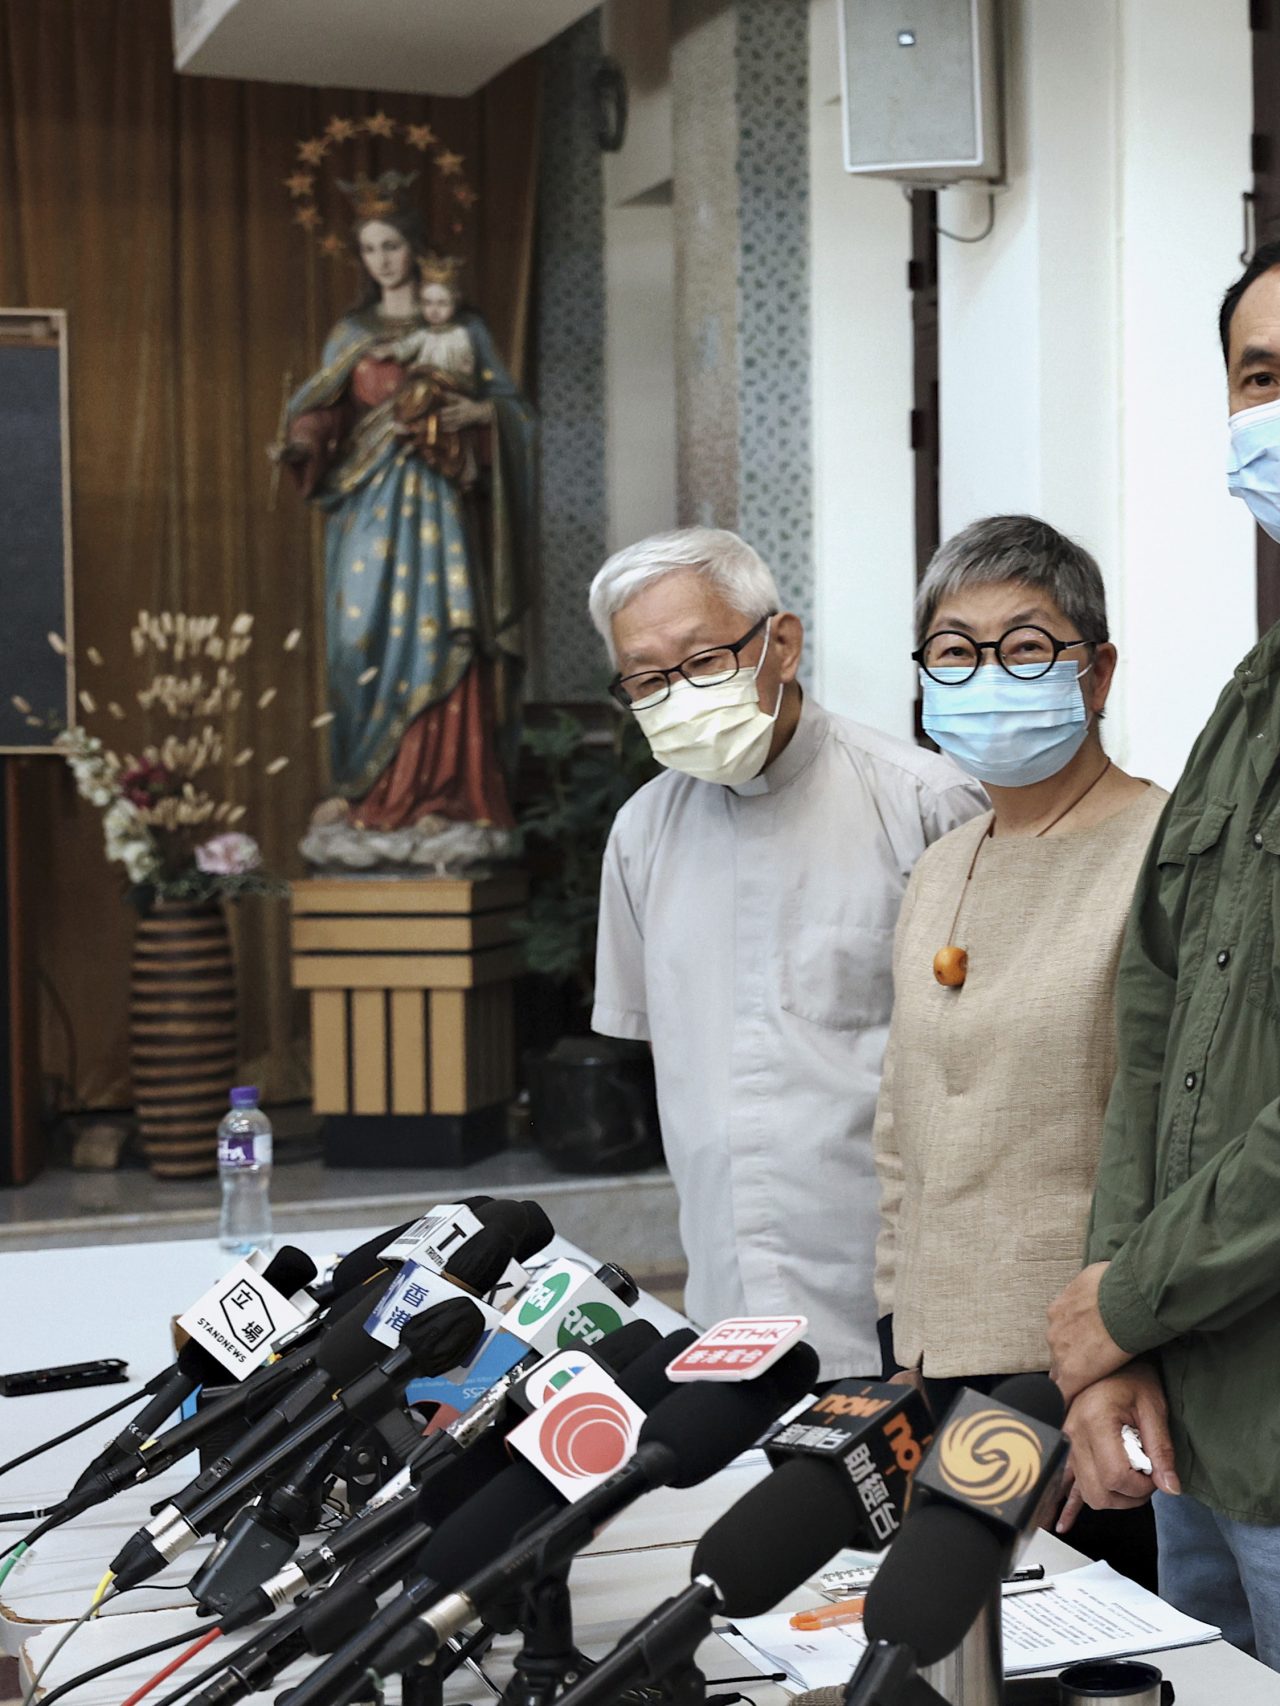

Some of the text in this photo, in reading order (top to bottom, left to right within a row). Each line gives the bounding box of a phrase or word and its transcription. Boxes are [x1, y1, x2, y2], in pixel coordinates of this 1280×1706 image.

[437, 1223, 467, 1252] T
[231, 1289, 264, 1343] 立場
[528, 1285, 556, 1311] RFA
[197, 1317, 247, 1363] STANDNEWS
[812, 1393, 892, 1418] now
[843, 1443, 900, 1540] 財經台
